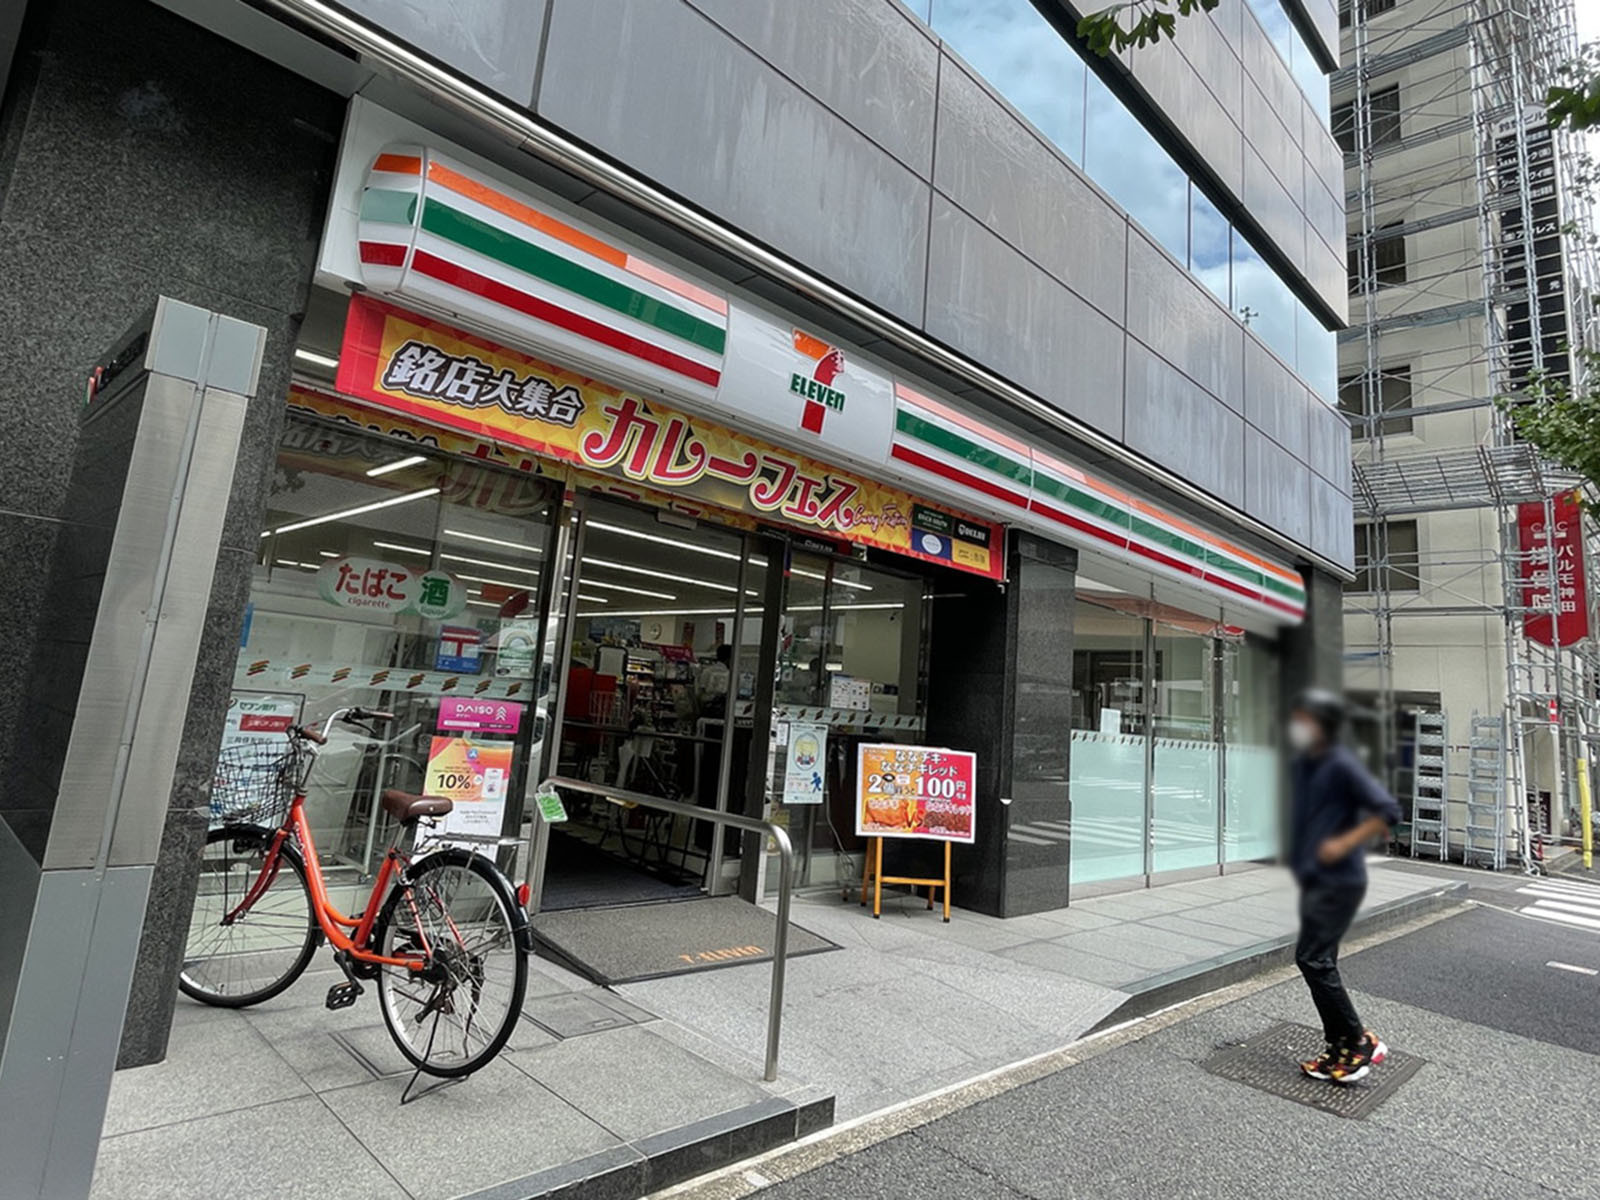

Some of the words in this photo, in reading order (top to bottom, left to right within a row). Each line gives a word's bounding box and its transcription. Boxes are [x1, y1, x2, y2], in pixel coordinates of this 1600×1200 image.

[386, 342, 585, 425] 銘店大集合
[582, 397, 859, 528] カレーフェス
[335, 563, 408, 601] たばこ
[419, 576, 451, 607] 酒
[456, 704, 494, 716] DAISO
[438, 774, 471, 790] 10%
